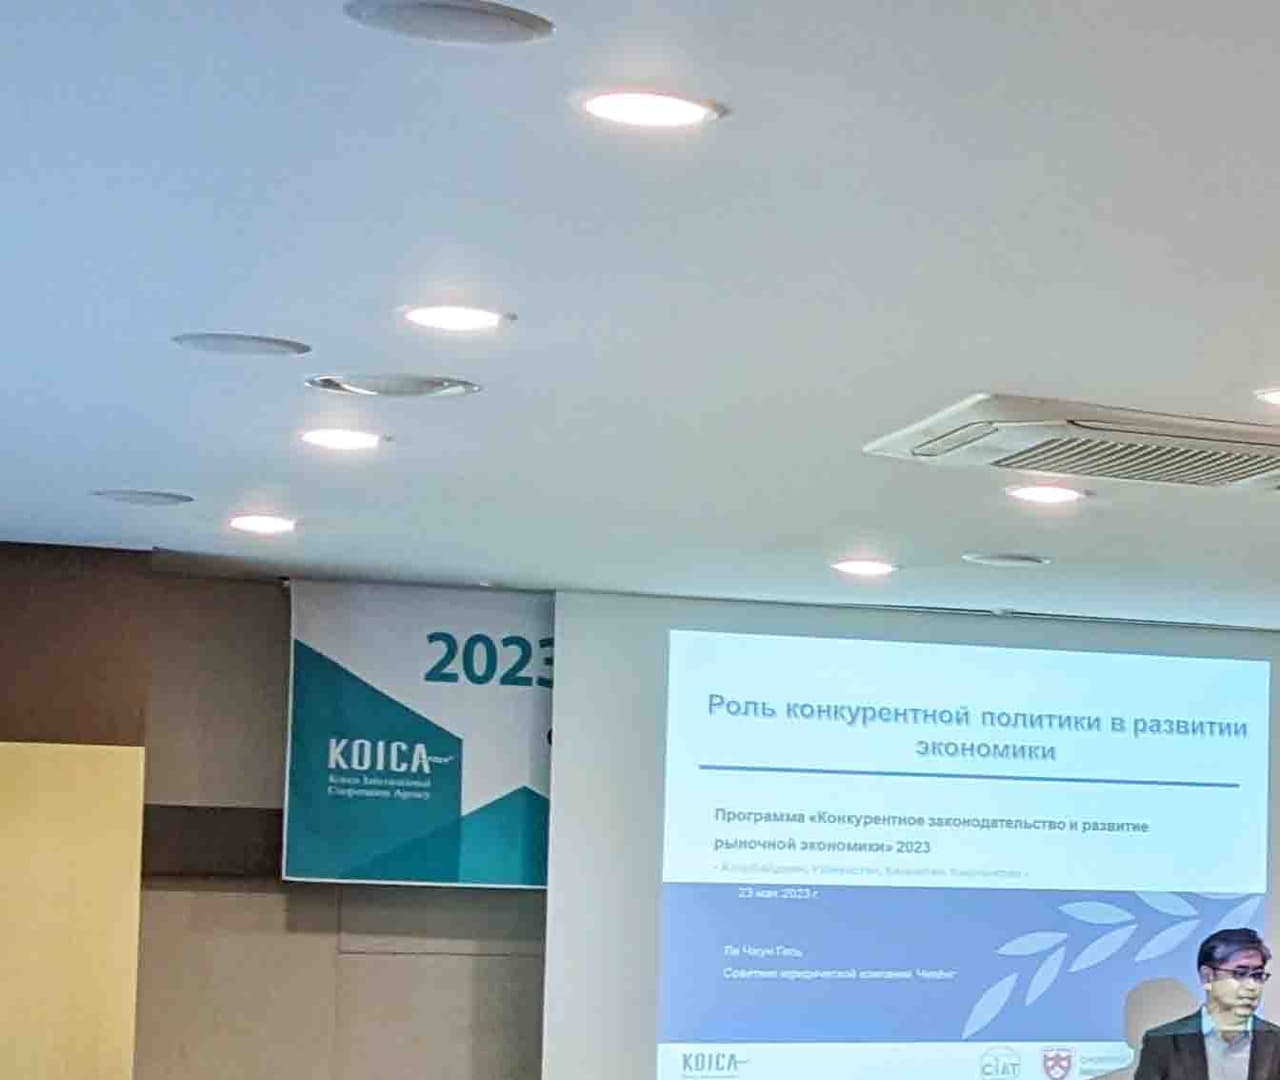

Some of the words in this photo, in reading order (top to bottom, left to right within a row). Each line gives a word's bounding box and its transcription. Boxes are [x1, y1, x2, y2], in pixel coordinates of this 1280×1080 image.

[708, 694, 777, 718] Роль
[786, 701, 970, 727] конкурентной
[981, 711, 1101, 732] политики
[1111, 717, 1125, 732] в
[1133, 718, 1248, 738] развитии
[328, 738, 431, 773] KOICA
[915, 740, 1056, 761] экономики
[714, 808, 805, 827] Программа
[928, 816, 1066, 832] законодательство
[1069, 820, 1078, 830] и
[1082, 821, 1150, 834] развитие
[714, 838, 796, 852] рыночной
[896, 841, 931, 854] 2023
[682, 1052, 739, 1072] KOICA
